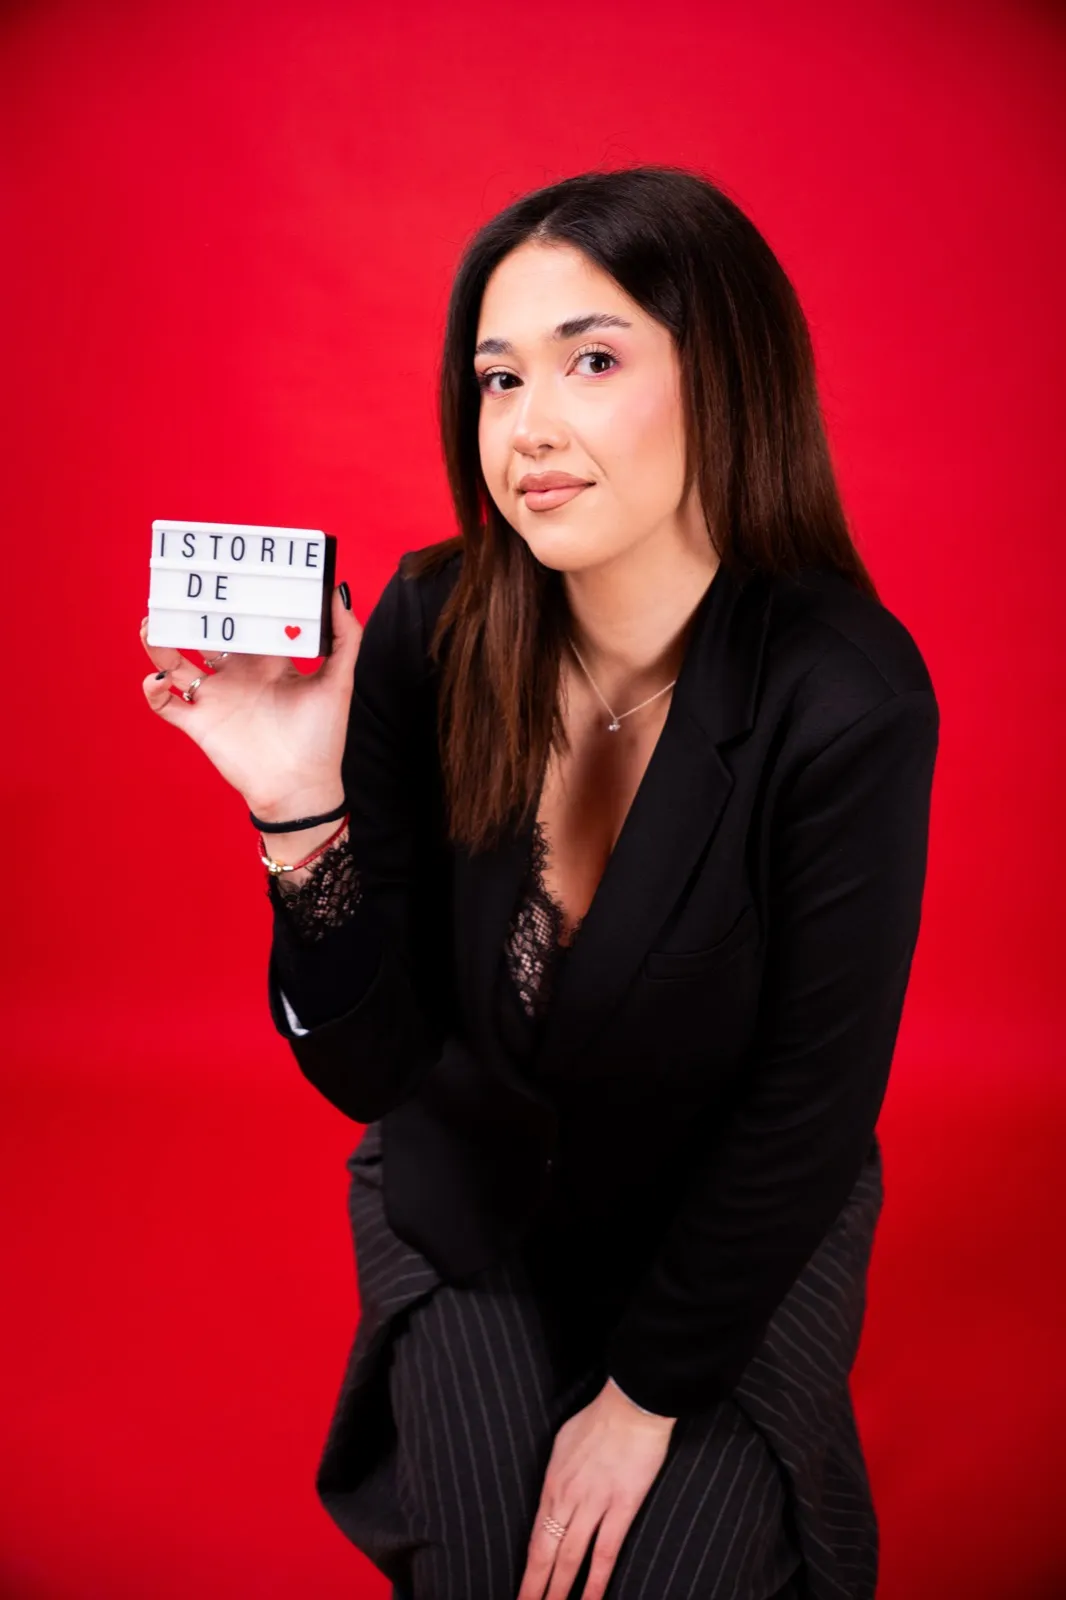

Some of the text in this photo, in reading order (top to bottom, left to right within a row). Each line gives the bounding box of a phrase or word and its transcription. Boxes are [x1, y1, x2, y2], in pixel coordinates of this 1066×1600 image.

[160, 532, 320, 568] ISTORIE
[186, 573, 229, 601] DE
[200, 615, 235, 641] 10
